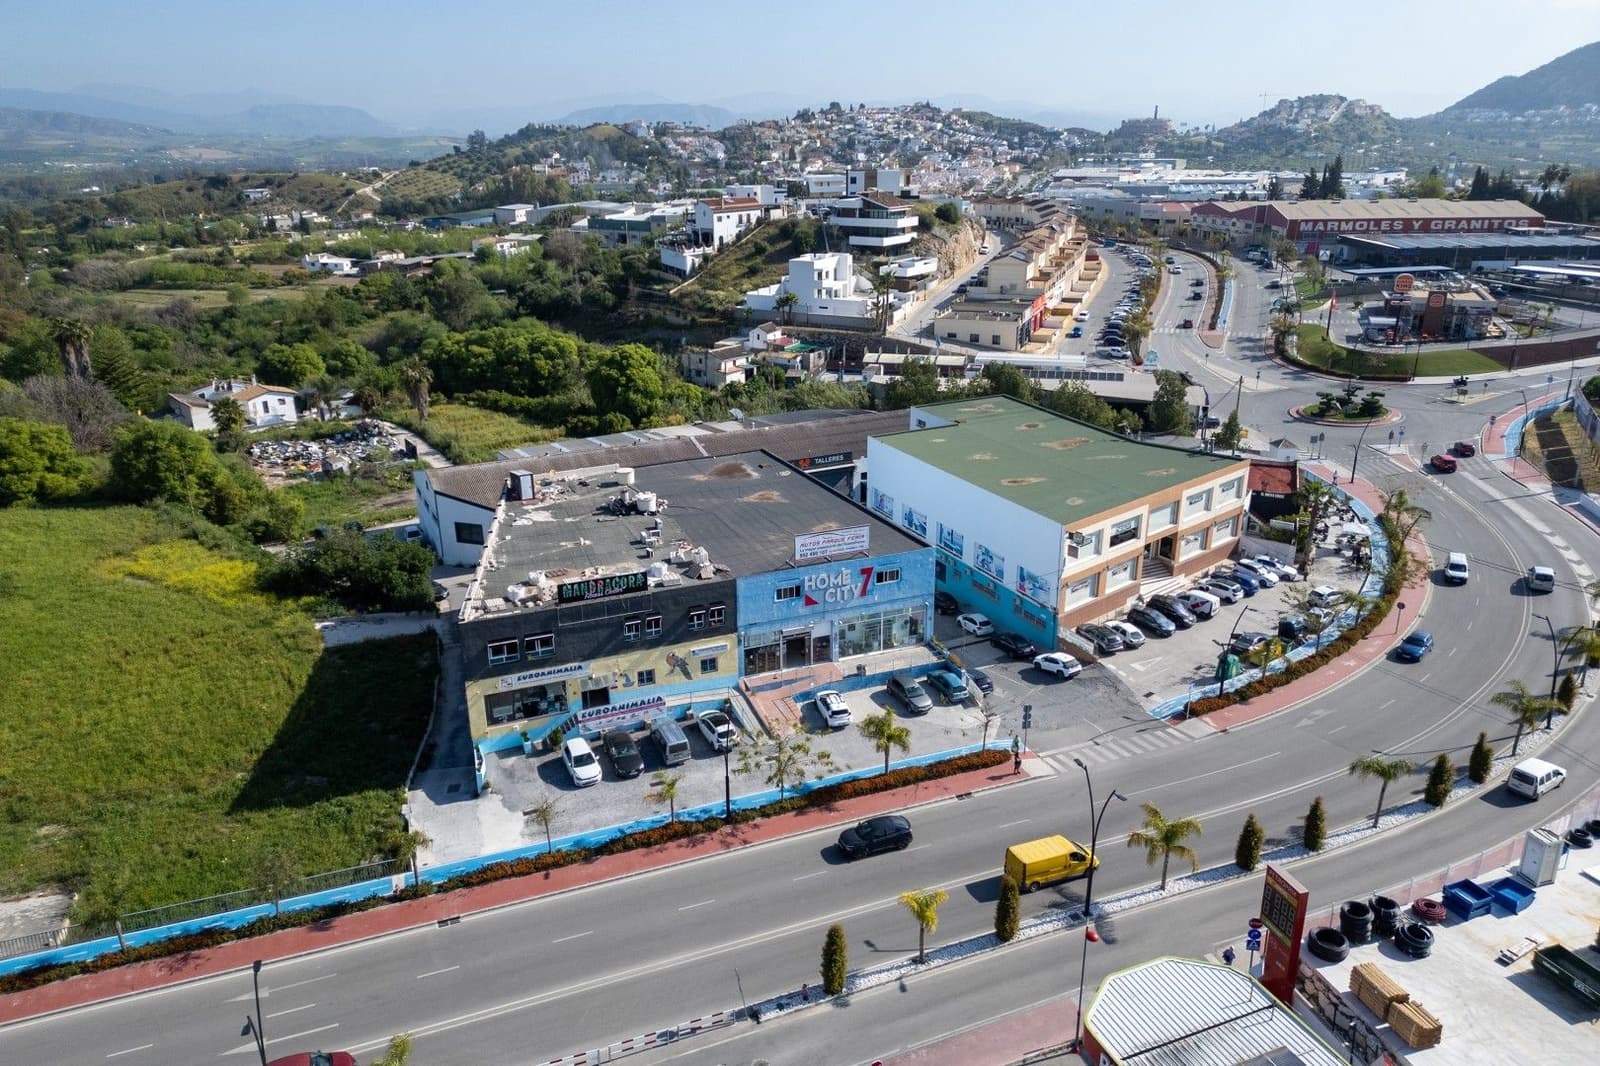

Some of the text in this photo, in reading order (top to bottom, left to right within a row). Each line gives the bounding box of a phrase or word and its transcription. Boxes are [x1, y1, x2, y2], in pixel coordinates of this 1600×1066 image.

[1300, 219, 1529, 231] MARMOLES Y GRANITOS
[804, 569, 851, 591] HOME
[859, 566, 875, 597] 7
[825, 583, 862, 602] CITY
[517, 665, 583, 681] EUROANIMALIA
[581, 696, 663, 719] EUROANIMALIA
